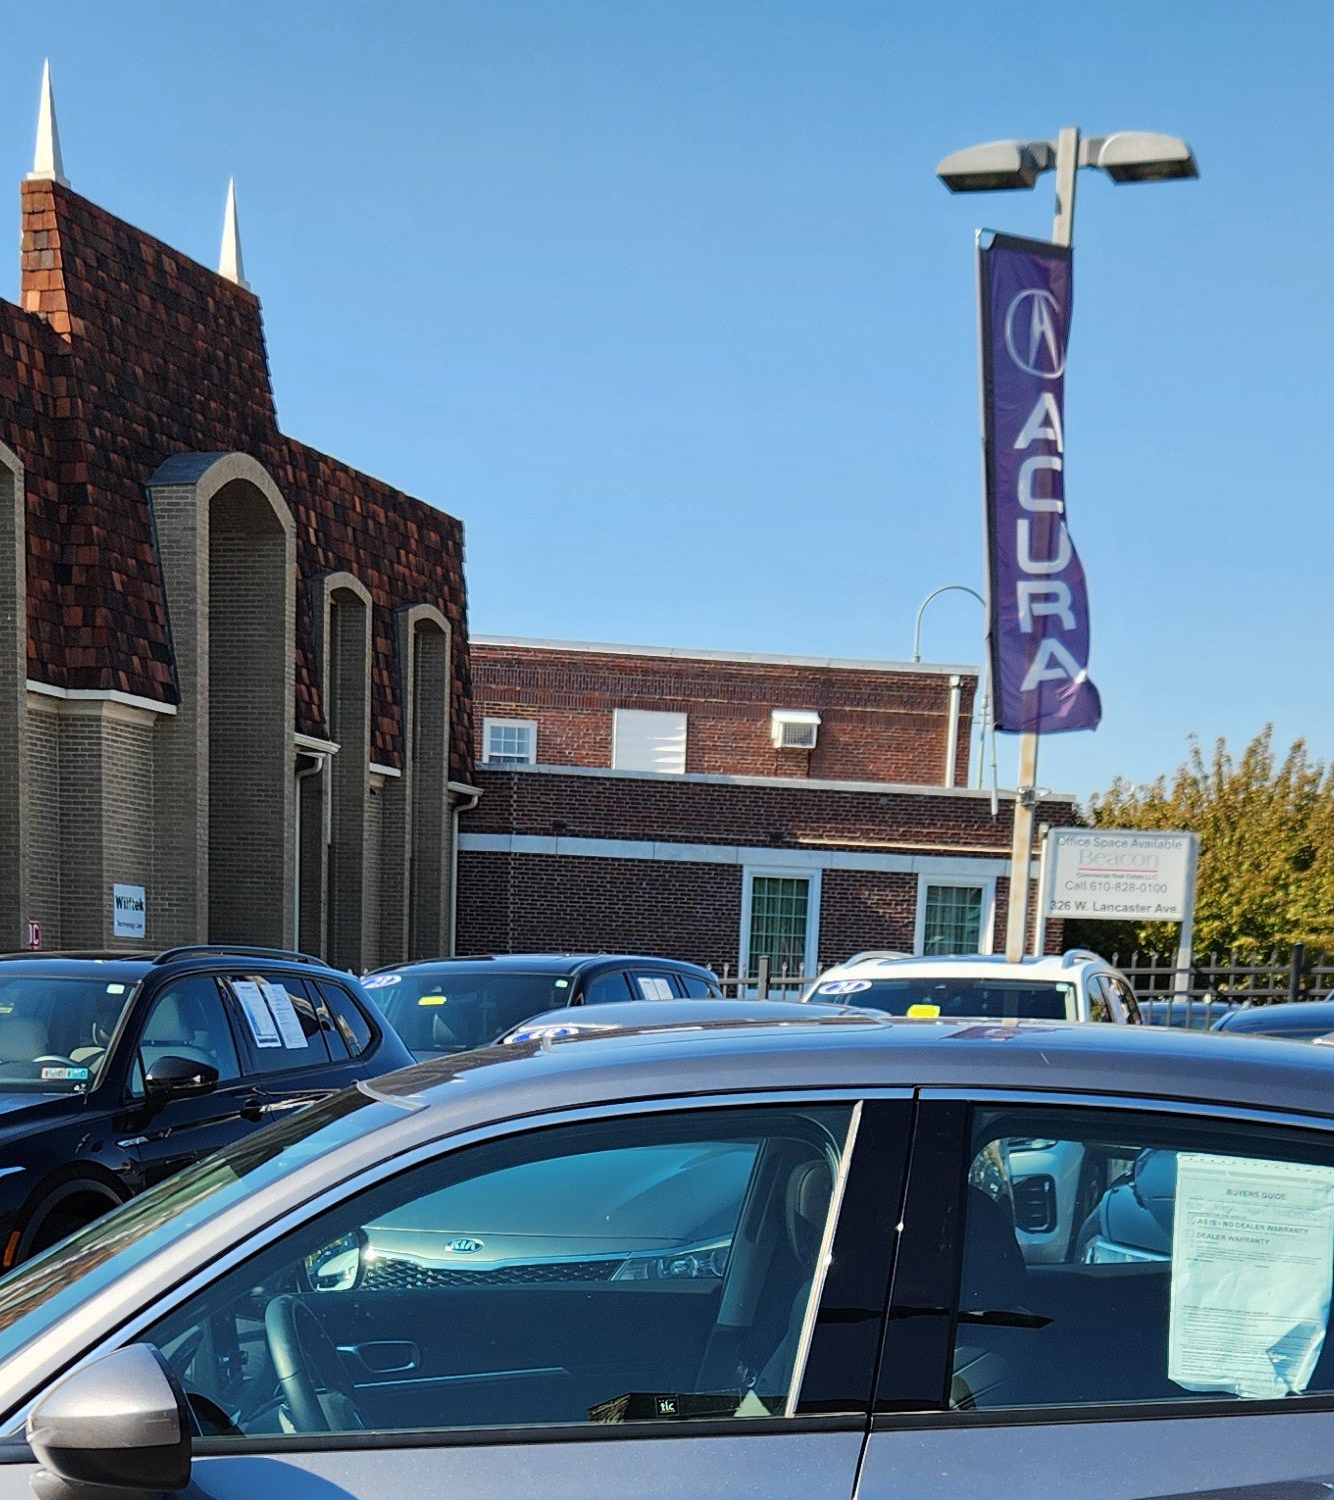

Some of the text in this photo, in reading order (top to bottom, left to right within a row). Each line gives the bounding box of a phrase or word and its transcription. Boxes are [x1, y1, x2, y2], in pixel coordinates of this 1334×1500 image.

[1013, 392, 1088, 692] ACURA
[1057, 837, 1183, 849] Office Space Available
[1078, 849, 1159, 868] Beacon
[1064, 881, 1087, 891] Call
[1092, 901, 1152, 913] Lancaster
[1226, 1188, 1287, 1201] BUYERS GUIDE
[1197, 1217, 1208, 1225] AS
[1223, 1220, 1234, 1228] NO
[1235, 1221, 1265, 1231] DEALER
[1267, 1225, 1309, 1234] WARRANTY
[450, 1239, 476, 1251] KIA
[1196, 1232, 1270, 1245] DEALER WARRANTY
